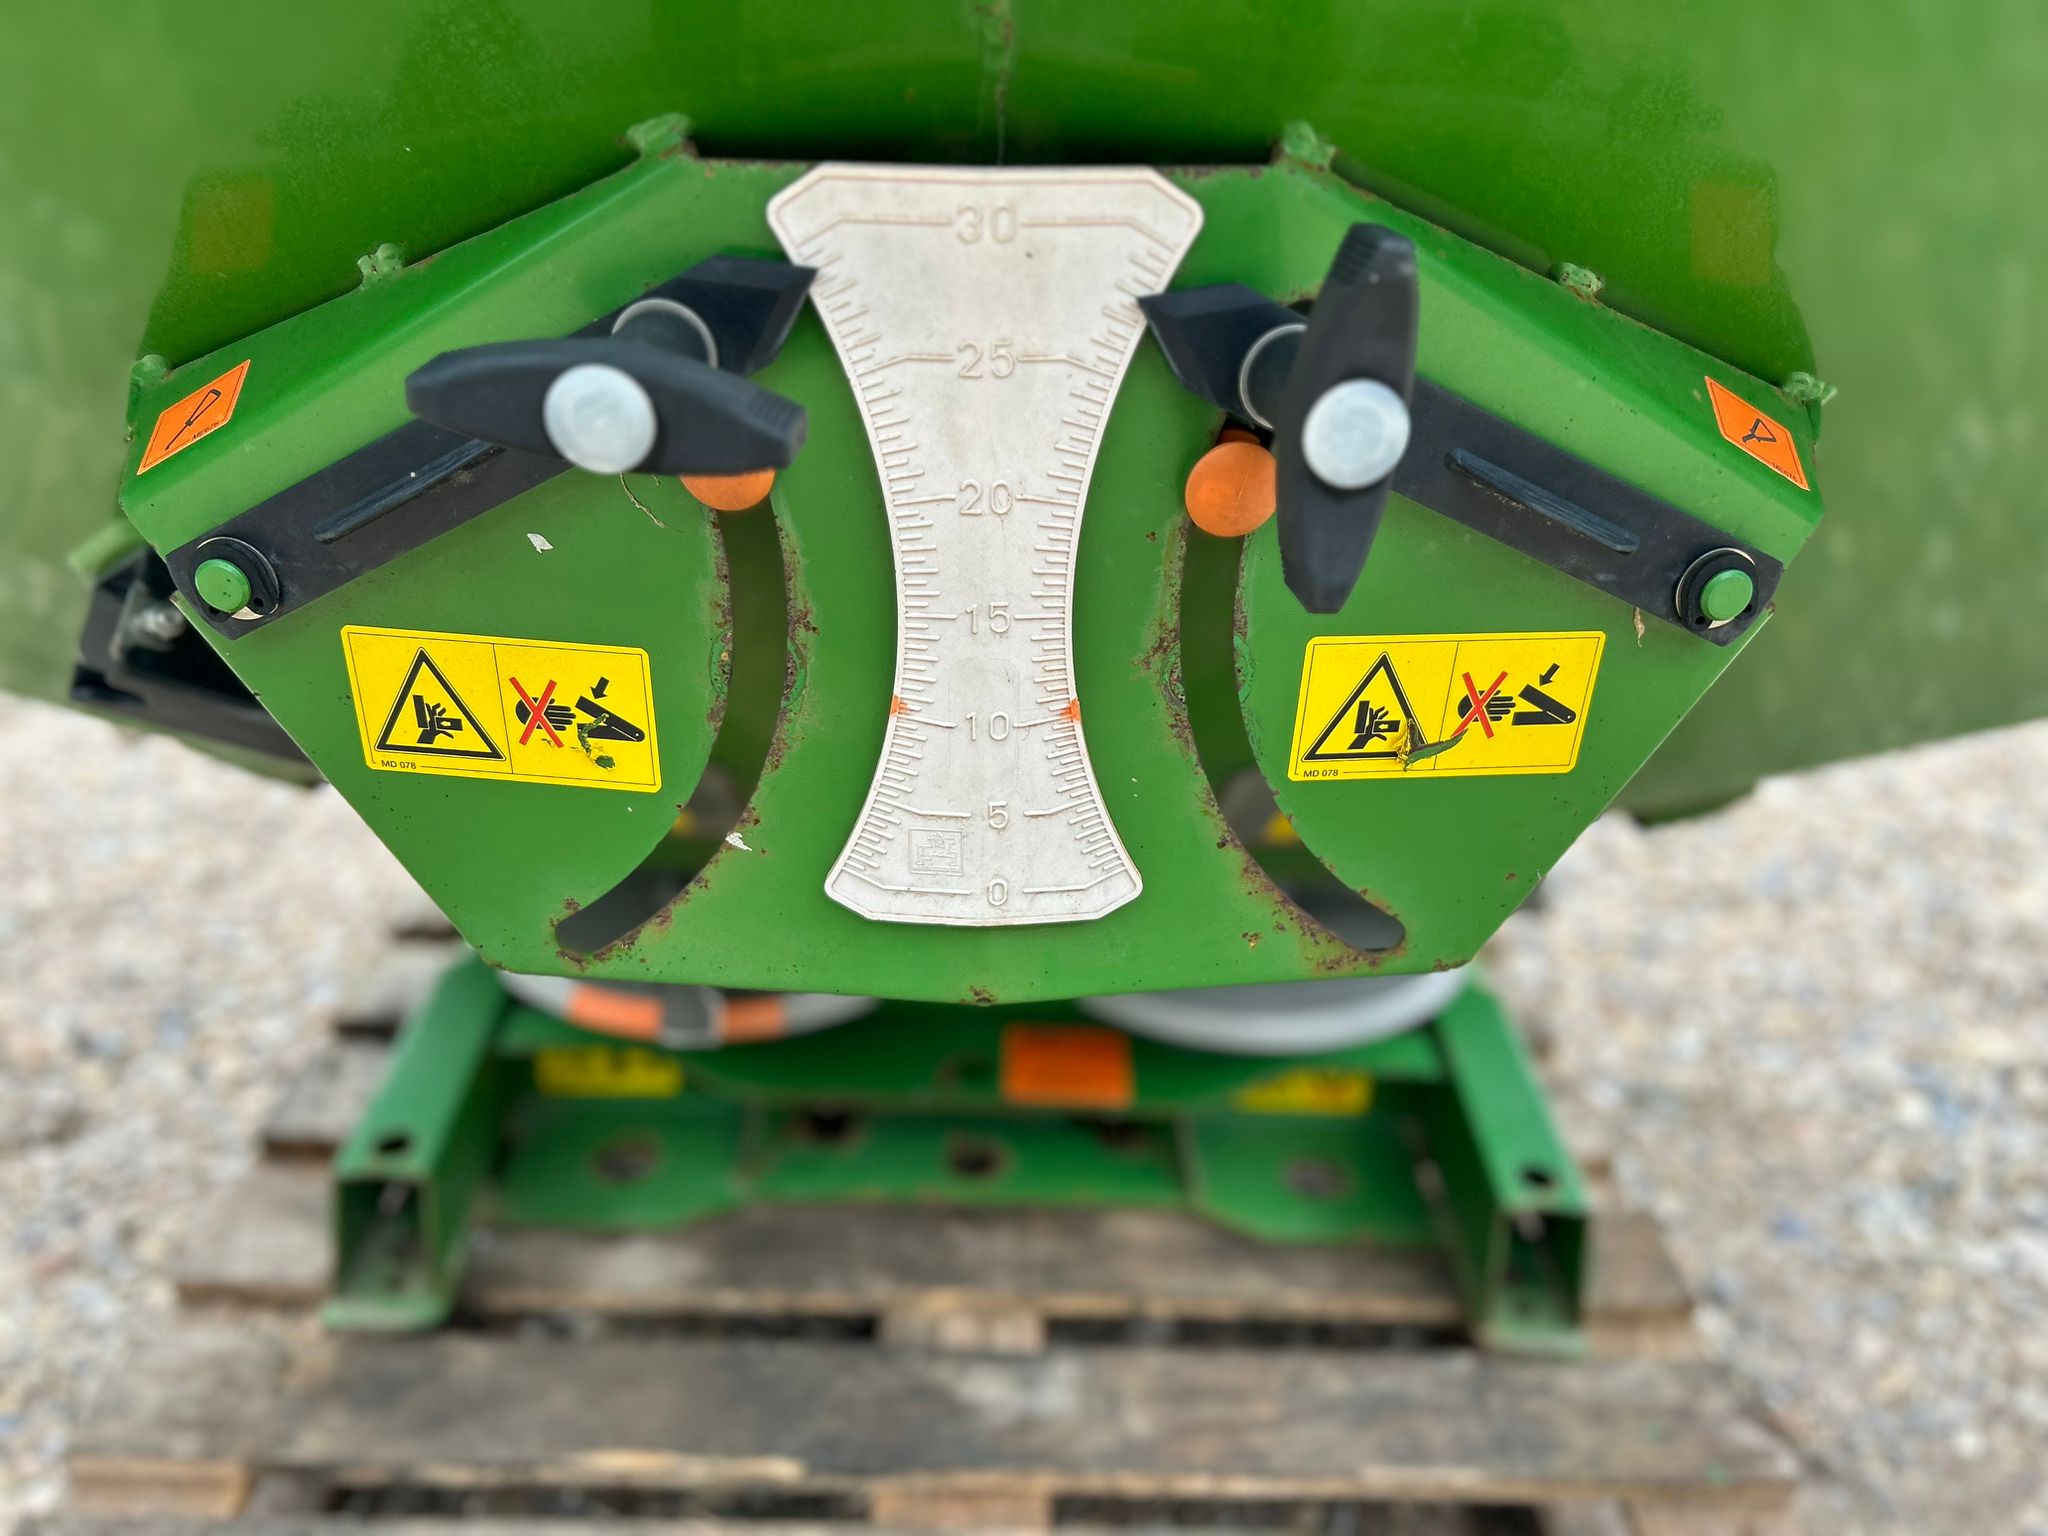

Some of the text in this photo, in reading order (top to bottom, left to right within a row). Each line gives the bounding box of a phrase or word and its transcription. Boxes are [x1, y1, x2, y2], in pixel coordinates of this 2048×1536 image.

[956, 203, 1018, 244] 30
[957, 340, 1017, 378] 25
[959, 479, 1014, 516] 20
[965, 601, 1012, 634] 15
[965, 711, 1011, 741] 10
[381, 760, 417, 770] MD 078
[1303, 768, 1339, 778] MD 078
[987, 800, 1009, 830] 5
[987, 878, 1009, 906] 0
